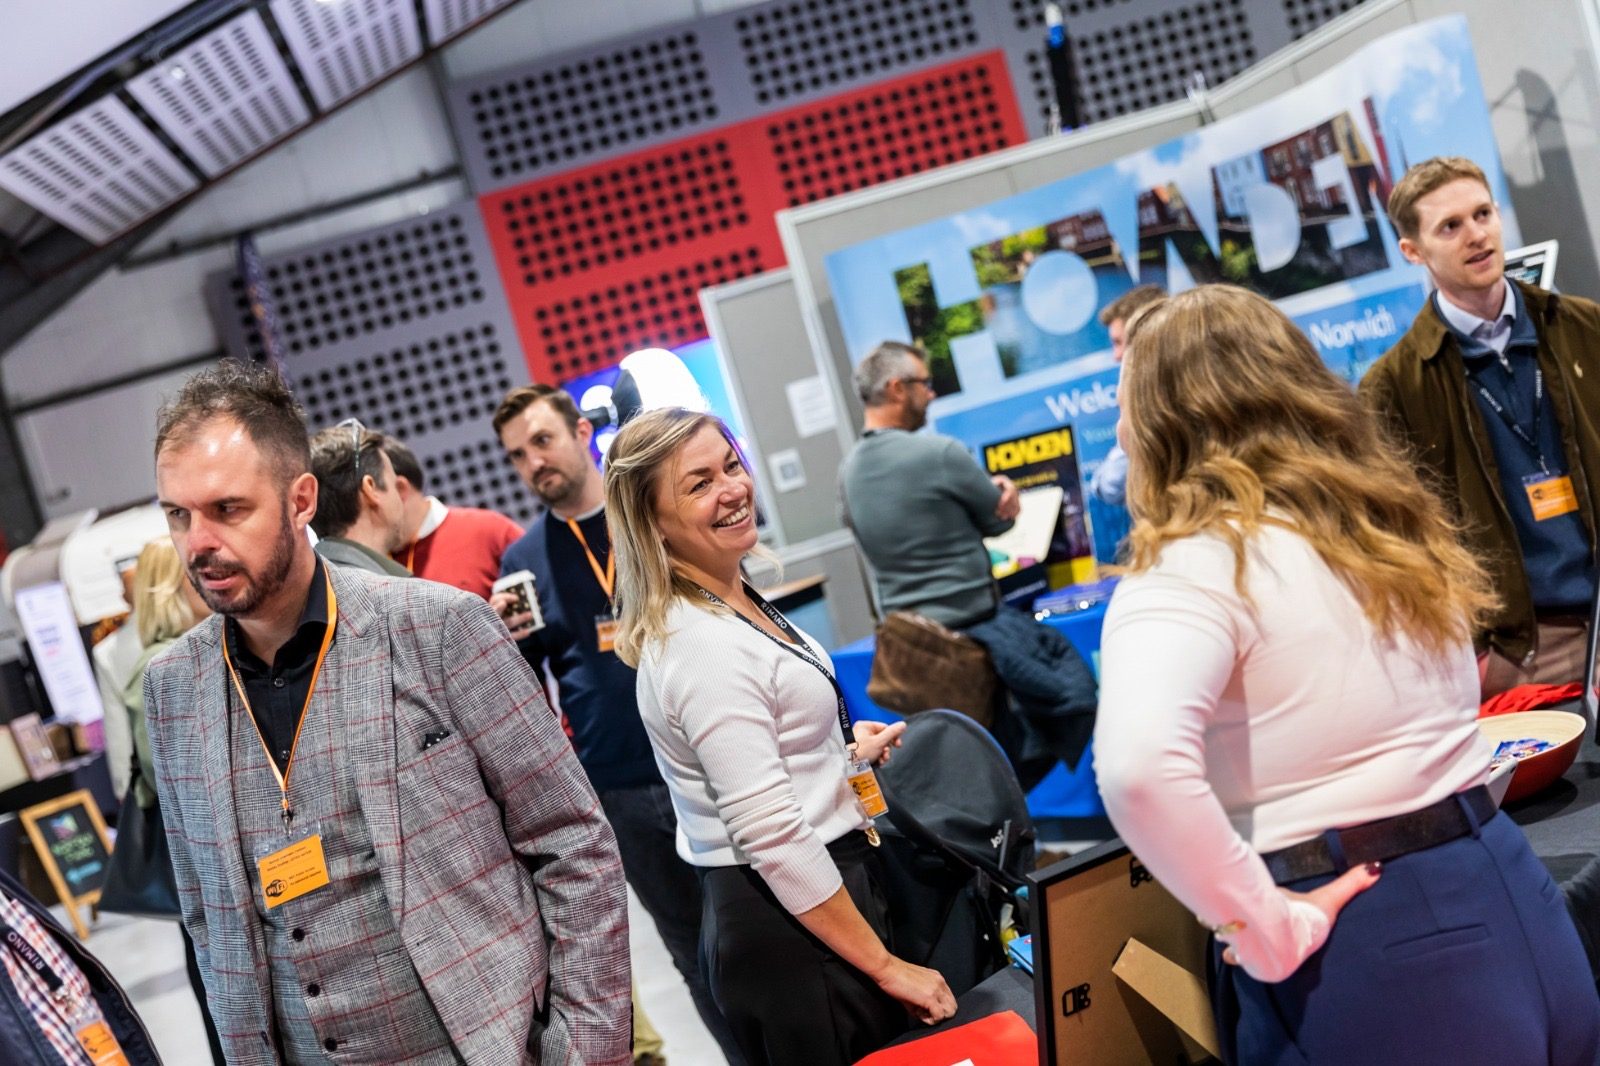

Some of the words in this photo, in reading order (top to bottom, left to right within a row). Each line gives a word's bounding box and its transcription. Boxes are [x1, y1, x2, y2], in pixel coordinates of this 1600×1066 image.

[1308, 304, 1397, 352] Norwich
[760, 601, 788, 629] RIMANO
[838, 697, 850, 729] RIMANO
[7, 931, 46, 971] RIMANO
